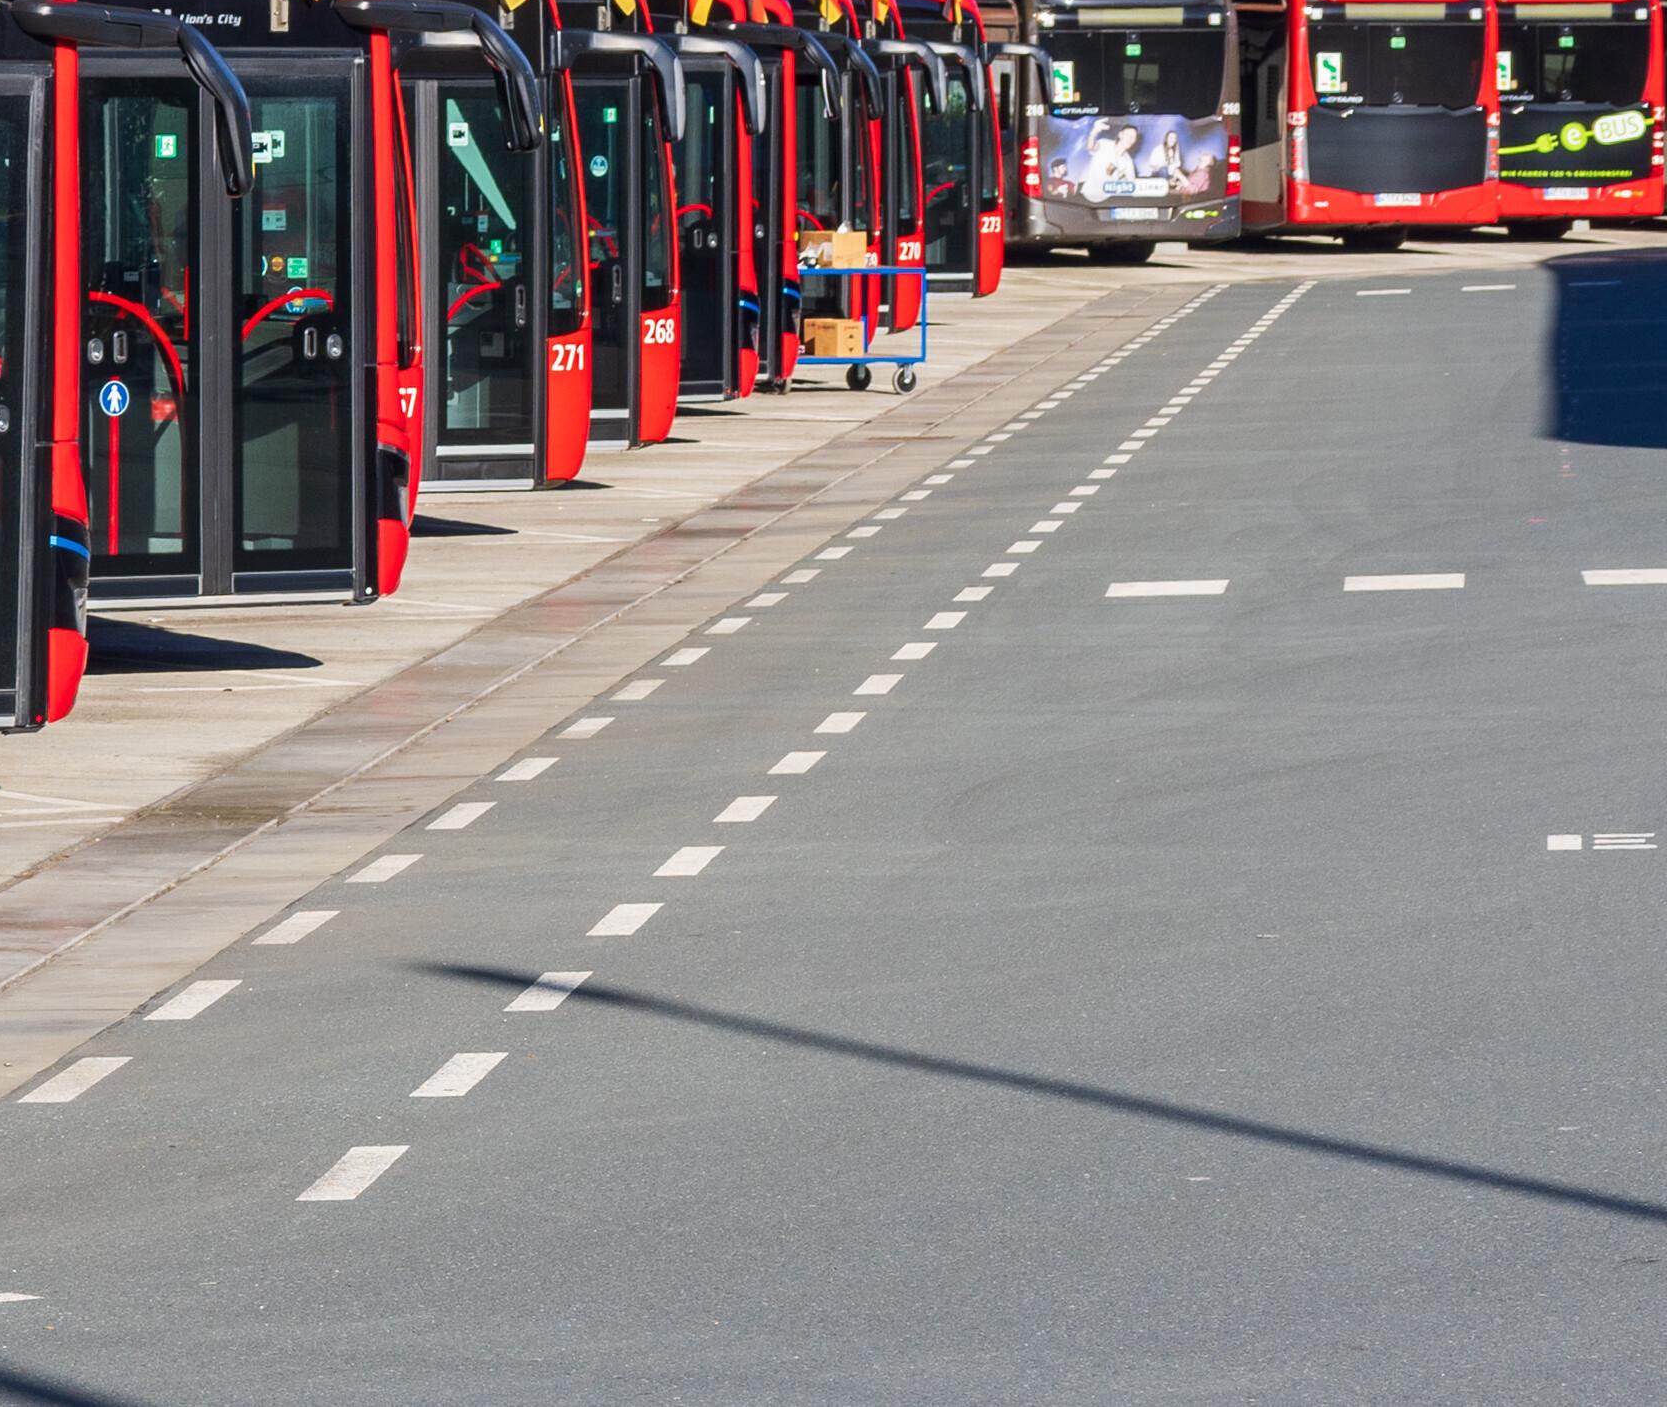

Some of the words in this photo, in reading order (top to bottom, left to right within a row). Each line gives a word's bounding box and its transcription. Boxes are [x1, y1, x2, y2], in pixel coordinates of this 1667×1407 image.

[217, 13, 242, 26] City
[1599, 115, 1641, 140] BUS
[980, 216, 1001, 233] 273
[899, 242, 921, 260] 270
[643, 319, 674, 344] 268
[551, 344, 584, 371] 271
